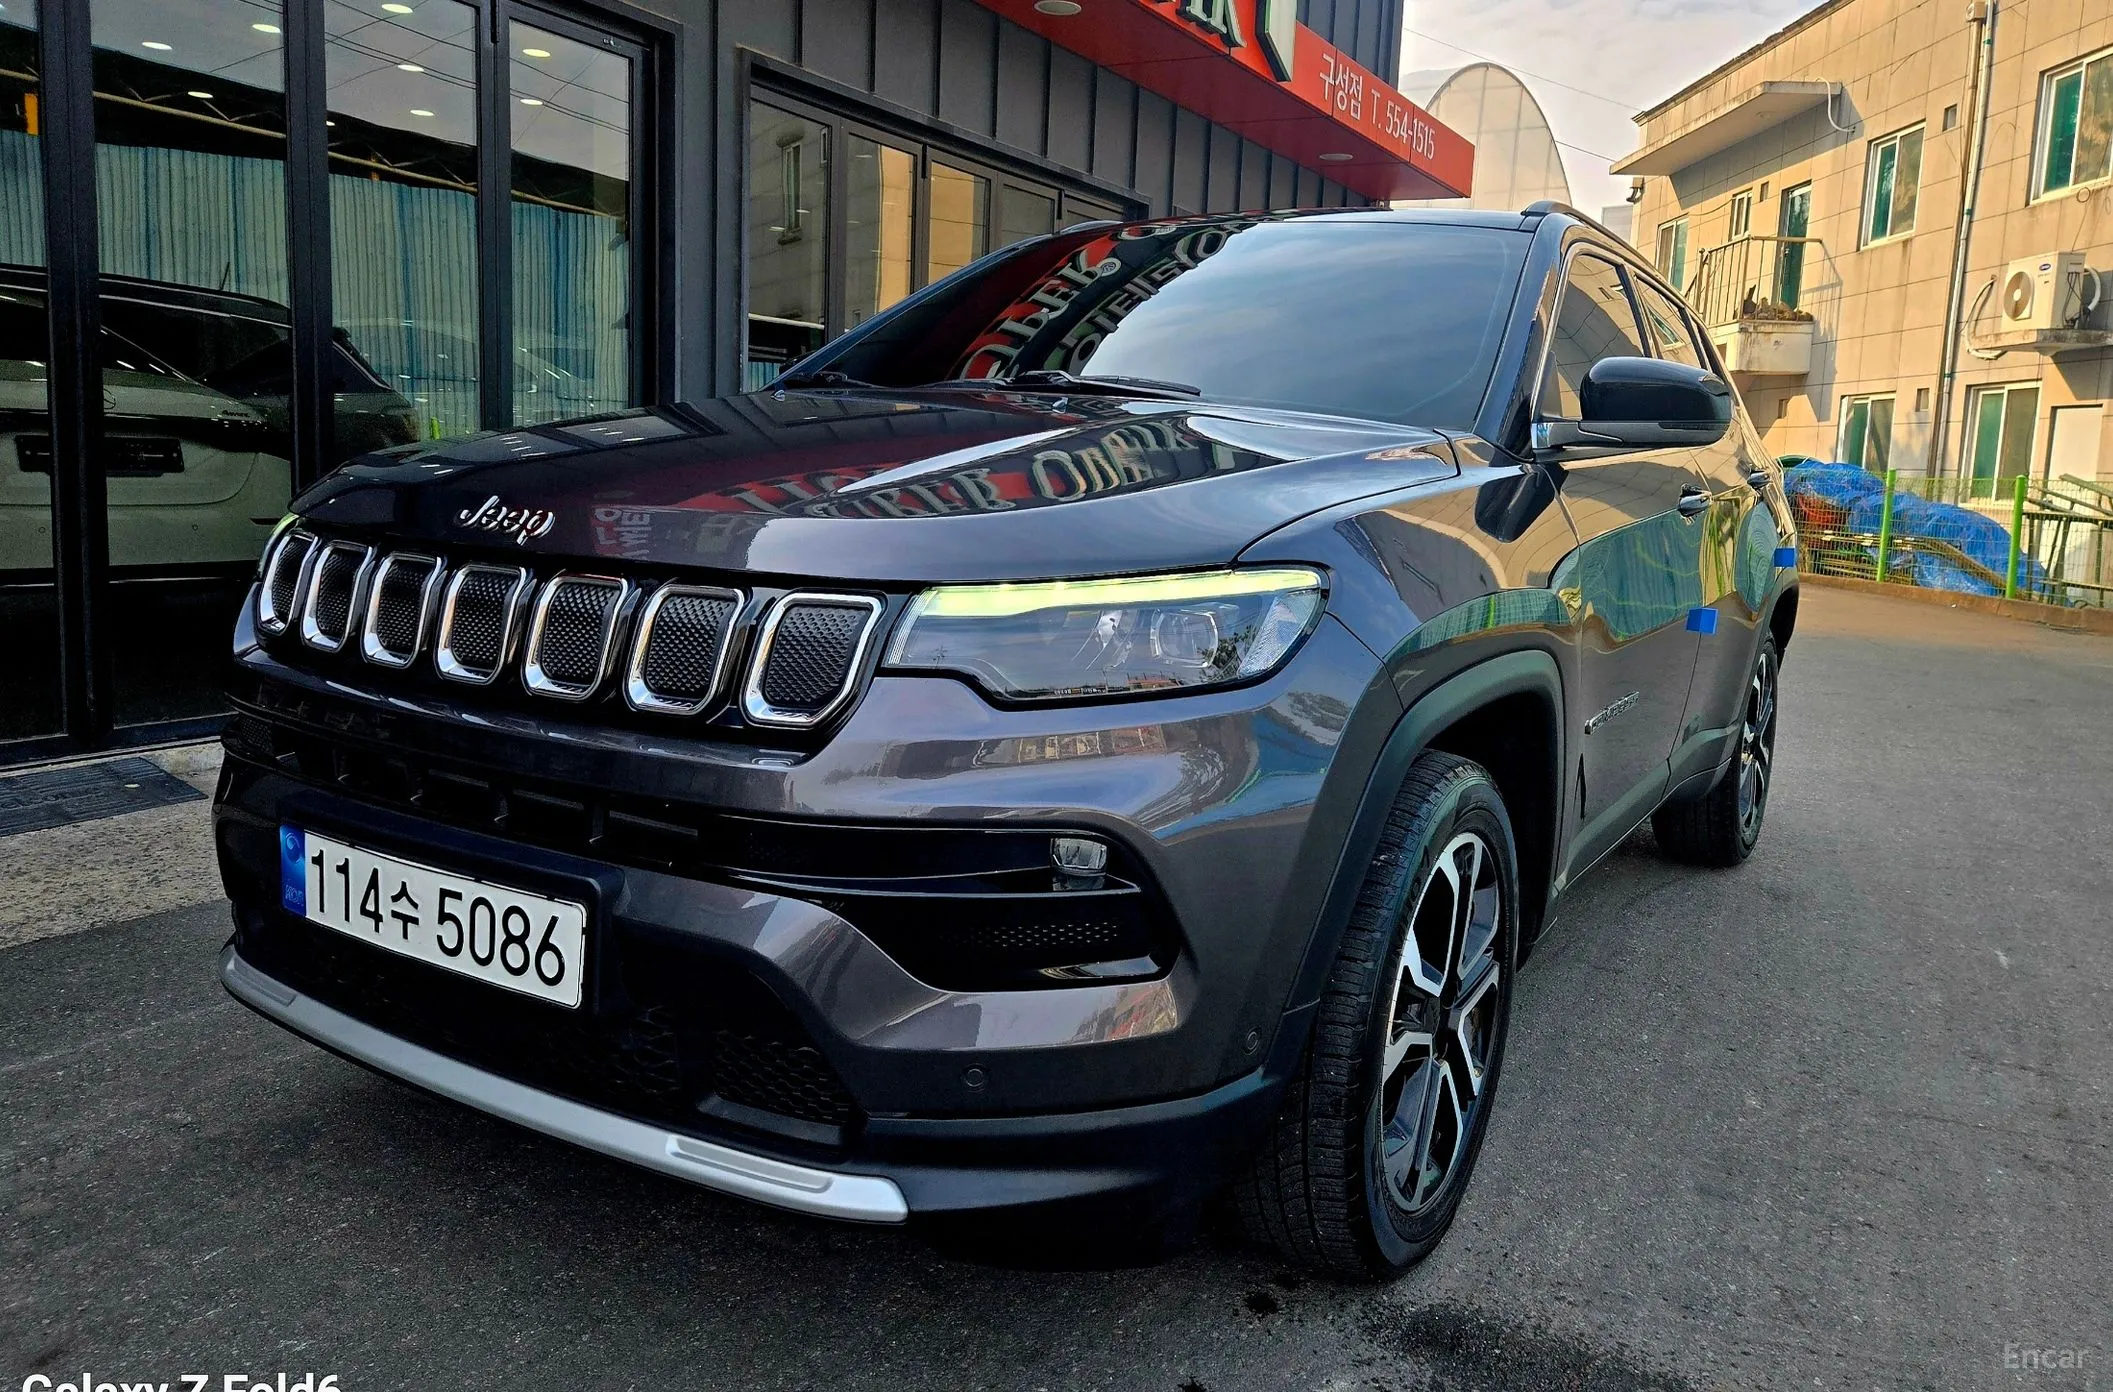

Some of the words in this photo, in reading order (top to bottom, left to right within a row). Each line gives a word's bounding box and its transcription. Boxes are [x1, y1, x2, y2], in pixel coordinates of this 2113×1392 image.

[1319, 53, 1363, 121] 구성점
[1385, 99, 1436, 160] 554-1515
[458, 495, 555, 546] Jeep
[310, 848, 420, 941] 114수
[436, 886, 566, 987] 5086
